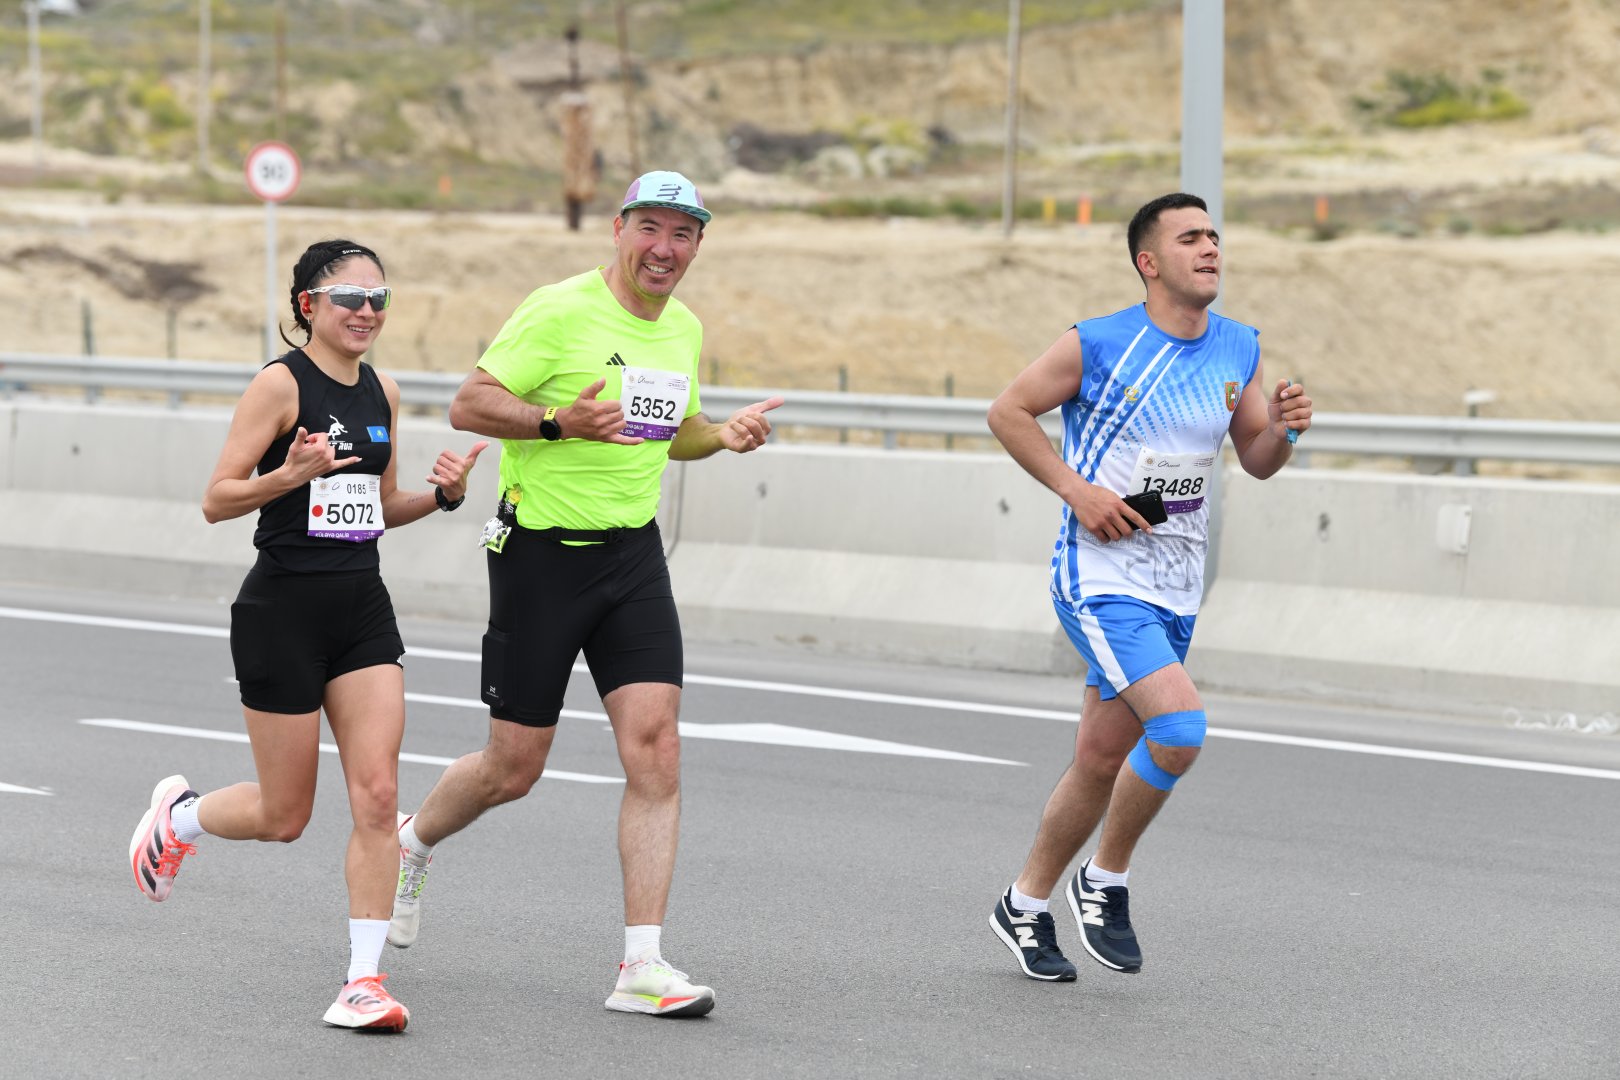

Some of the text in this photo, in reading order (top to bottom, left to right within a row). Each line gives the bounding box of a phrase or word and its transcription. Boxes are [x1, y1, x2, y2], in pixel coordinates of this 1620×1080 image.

[630, 396, 676, 421] 5352
[346, 483, 367, 495] 0185
[1143, 476, 1204, 497] 13488
[326, 503, 374, 525] 5072
[1081, 902, 1104, 927] N
[1014, 926, 1039, 948] N
